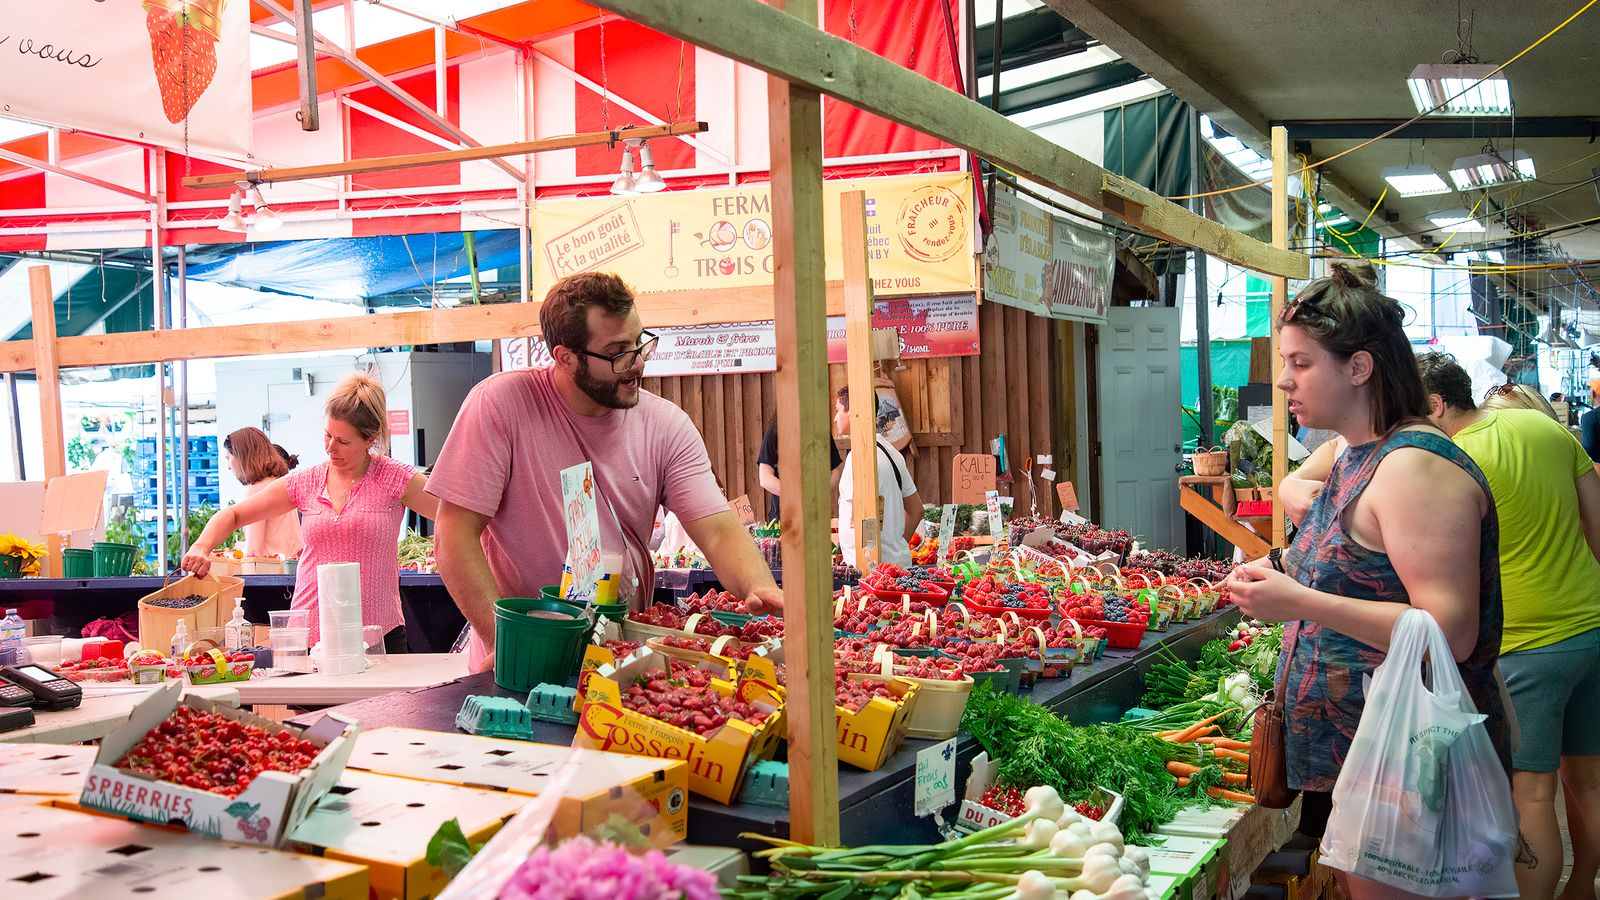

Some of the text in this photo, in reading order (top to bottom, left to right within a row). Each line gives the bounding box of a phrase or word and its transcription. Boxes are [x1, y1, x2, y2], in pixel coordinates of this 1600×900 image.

[18, 37, 102, 68] vous
[866, 223, 881, 234] uit
[928, 218, 939, 229] au
[555, 213, 626, 256] Le bon goût
[573, 254, 587, 267] la
[588, 228, 632, 261] qualité
[872, 276, 921, 289] HEZ VOUS
[936, 320, 969, 333] PURE
[959, 456, 992, 473] KALE
[623, 715, 649, 732] Ferme
[1443, 727, 1460, 739] THE
[579, 701, 724, 784] Gosselin
[88, 775, 193, 815] SPBERRIES
[965, 807, 984, 824] DU
